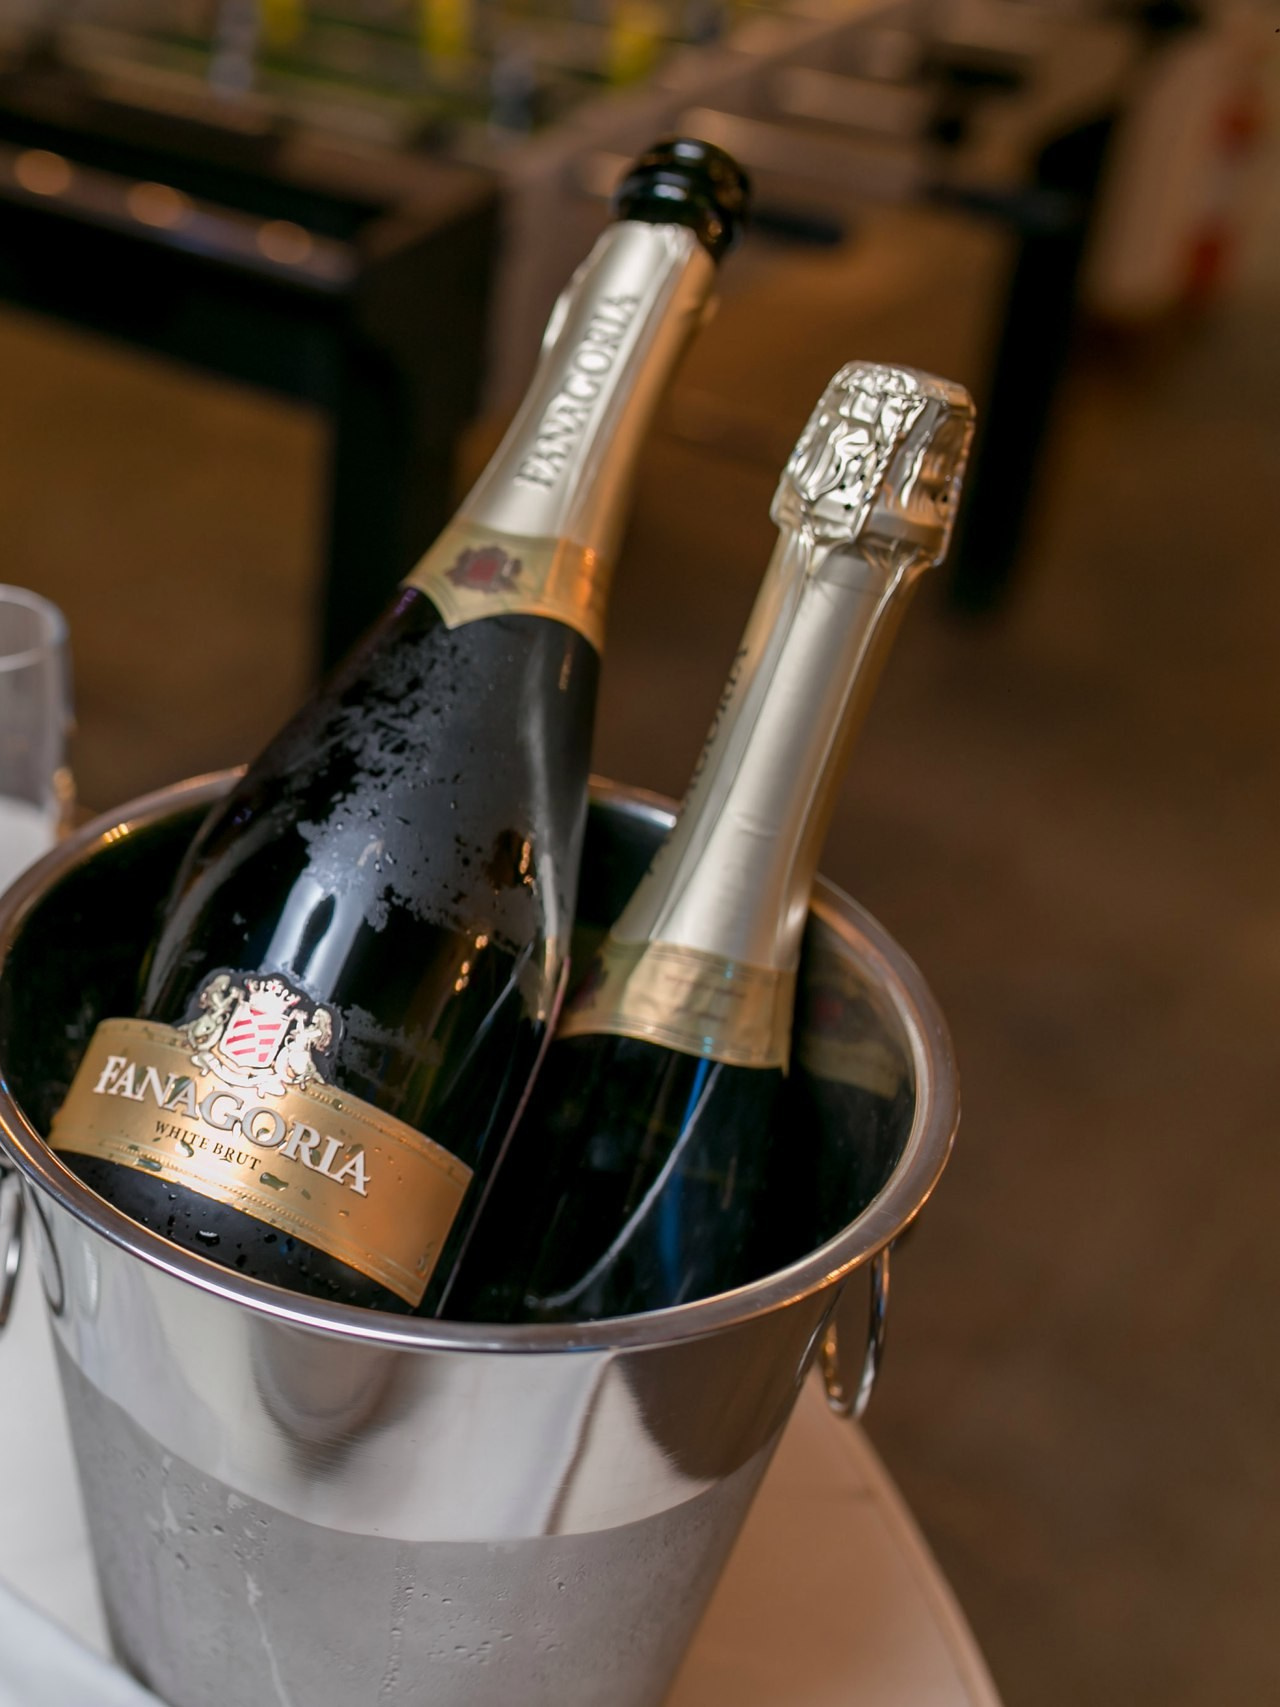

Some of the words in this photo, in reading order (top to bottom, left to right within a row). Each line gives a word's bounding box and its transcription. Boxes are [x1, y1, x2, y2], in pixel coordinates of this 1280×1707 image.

[93, 1055, 371, 1199] FANAGORIA
[154, 1120, 208, 1150] WHITE
[213, 1142, 262, 1172] BRUT
